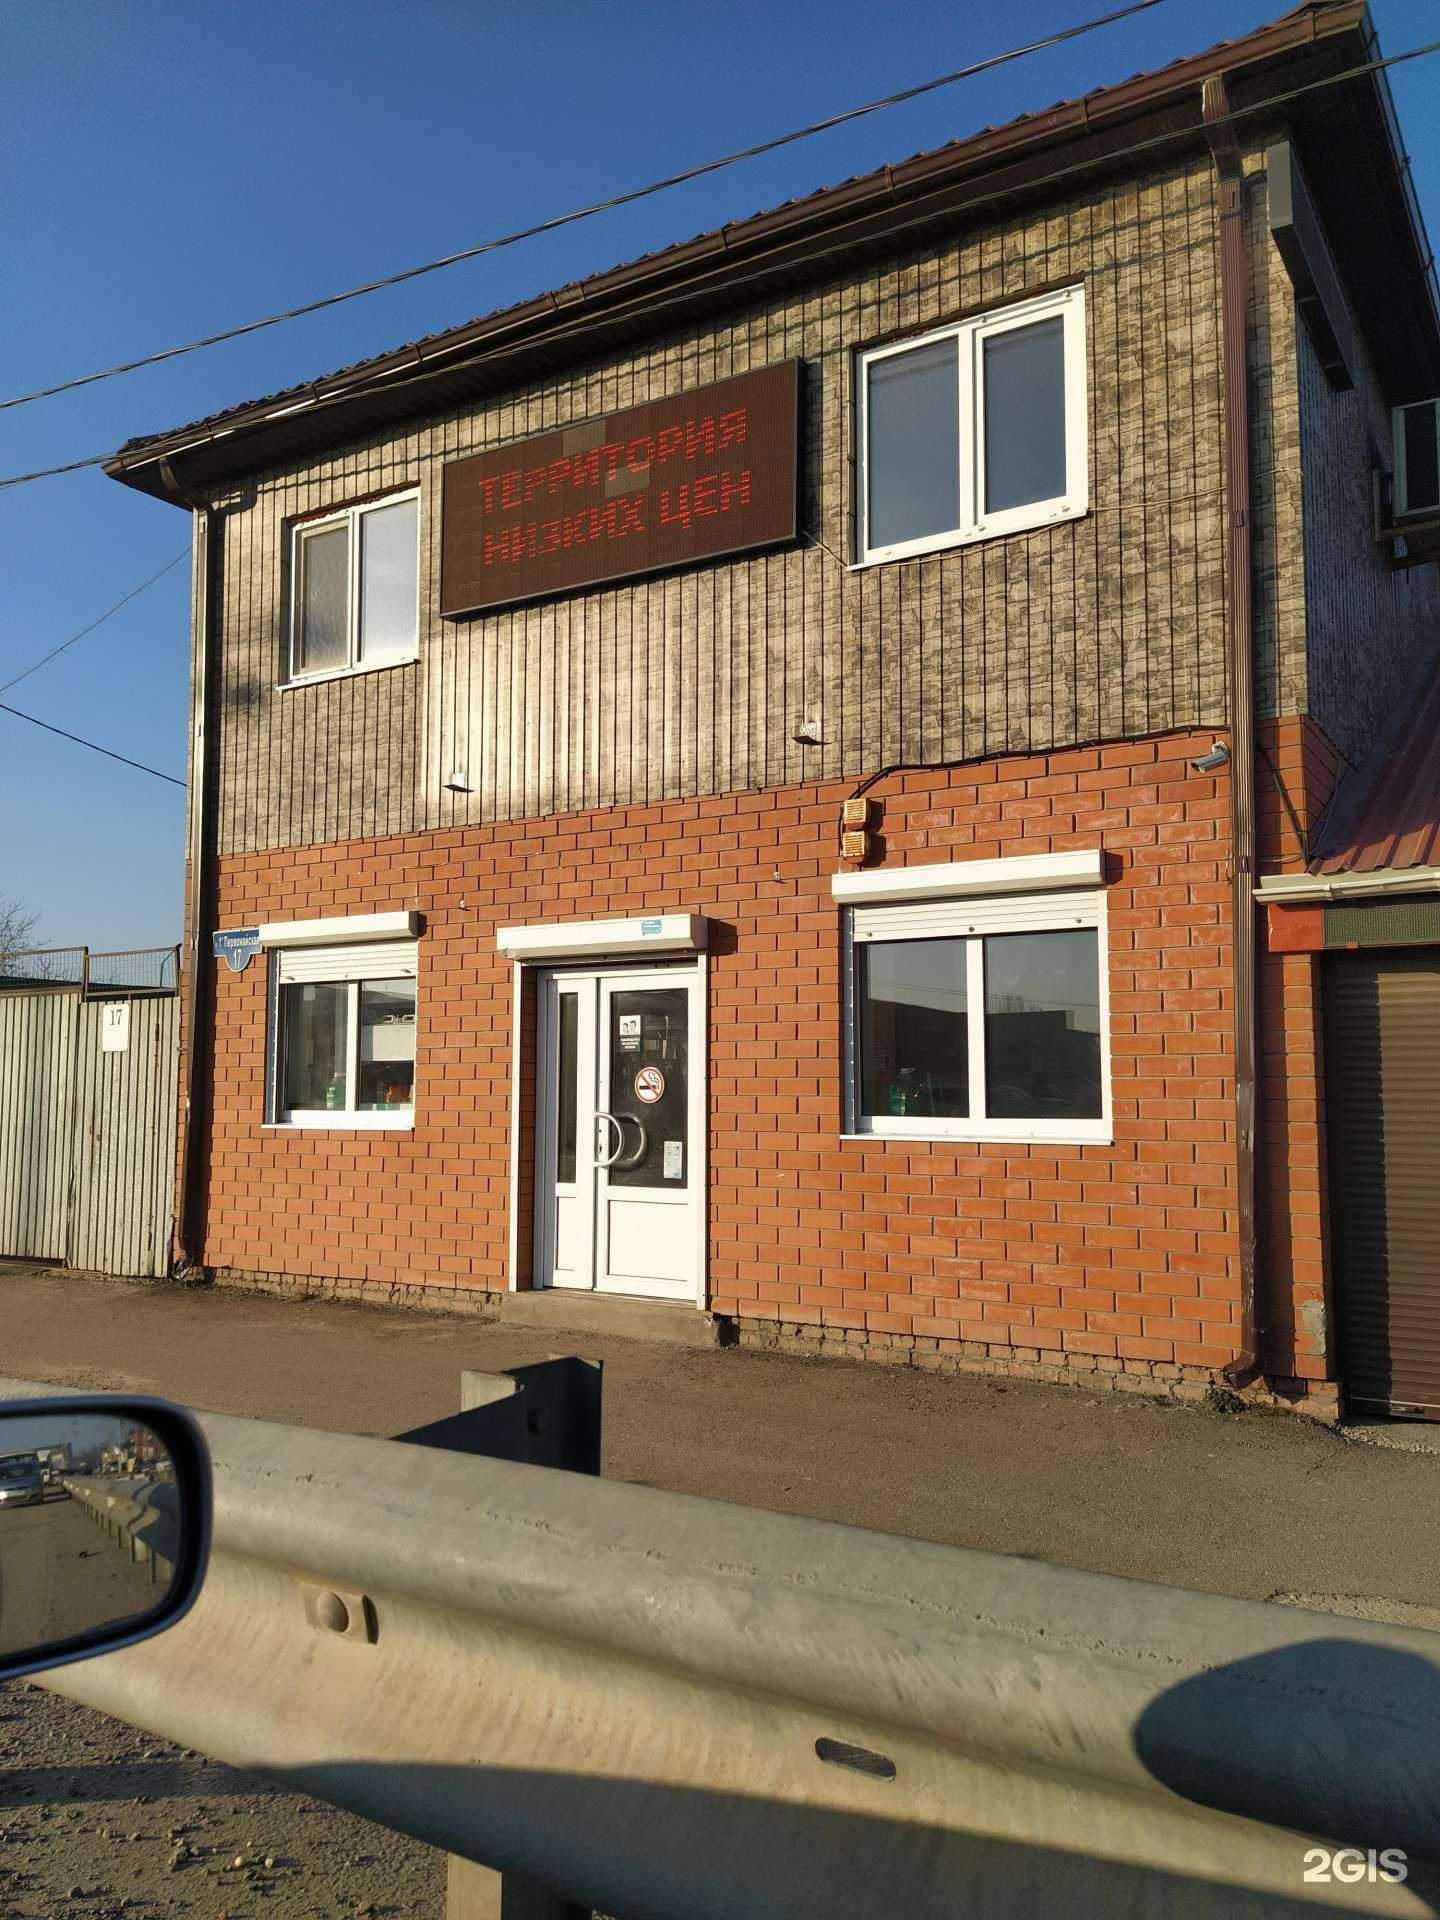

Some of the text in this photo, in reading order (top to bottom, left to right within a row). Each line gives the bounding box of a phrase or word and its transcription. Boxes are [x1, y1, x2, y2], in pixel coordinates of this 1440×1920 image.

[479, 408, 747, 514] ТЕРРИТОРИЯ
[484, 470, 751, 566] НИЗКИХ ЦЕН
[234, 949, 241, 969] 17
[110, 1008, 123, 1026] 17
